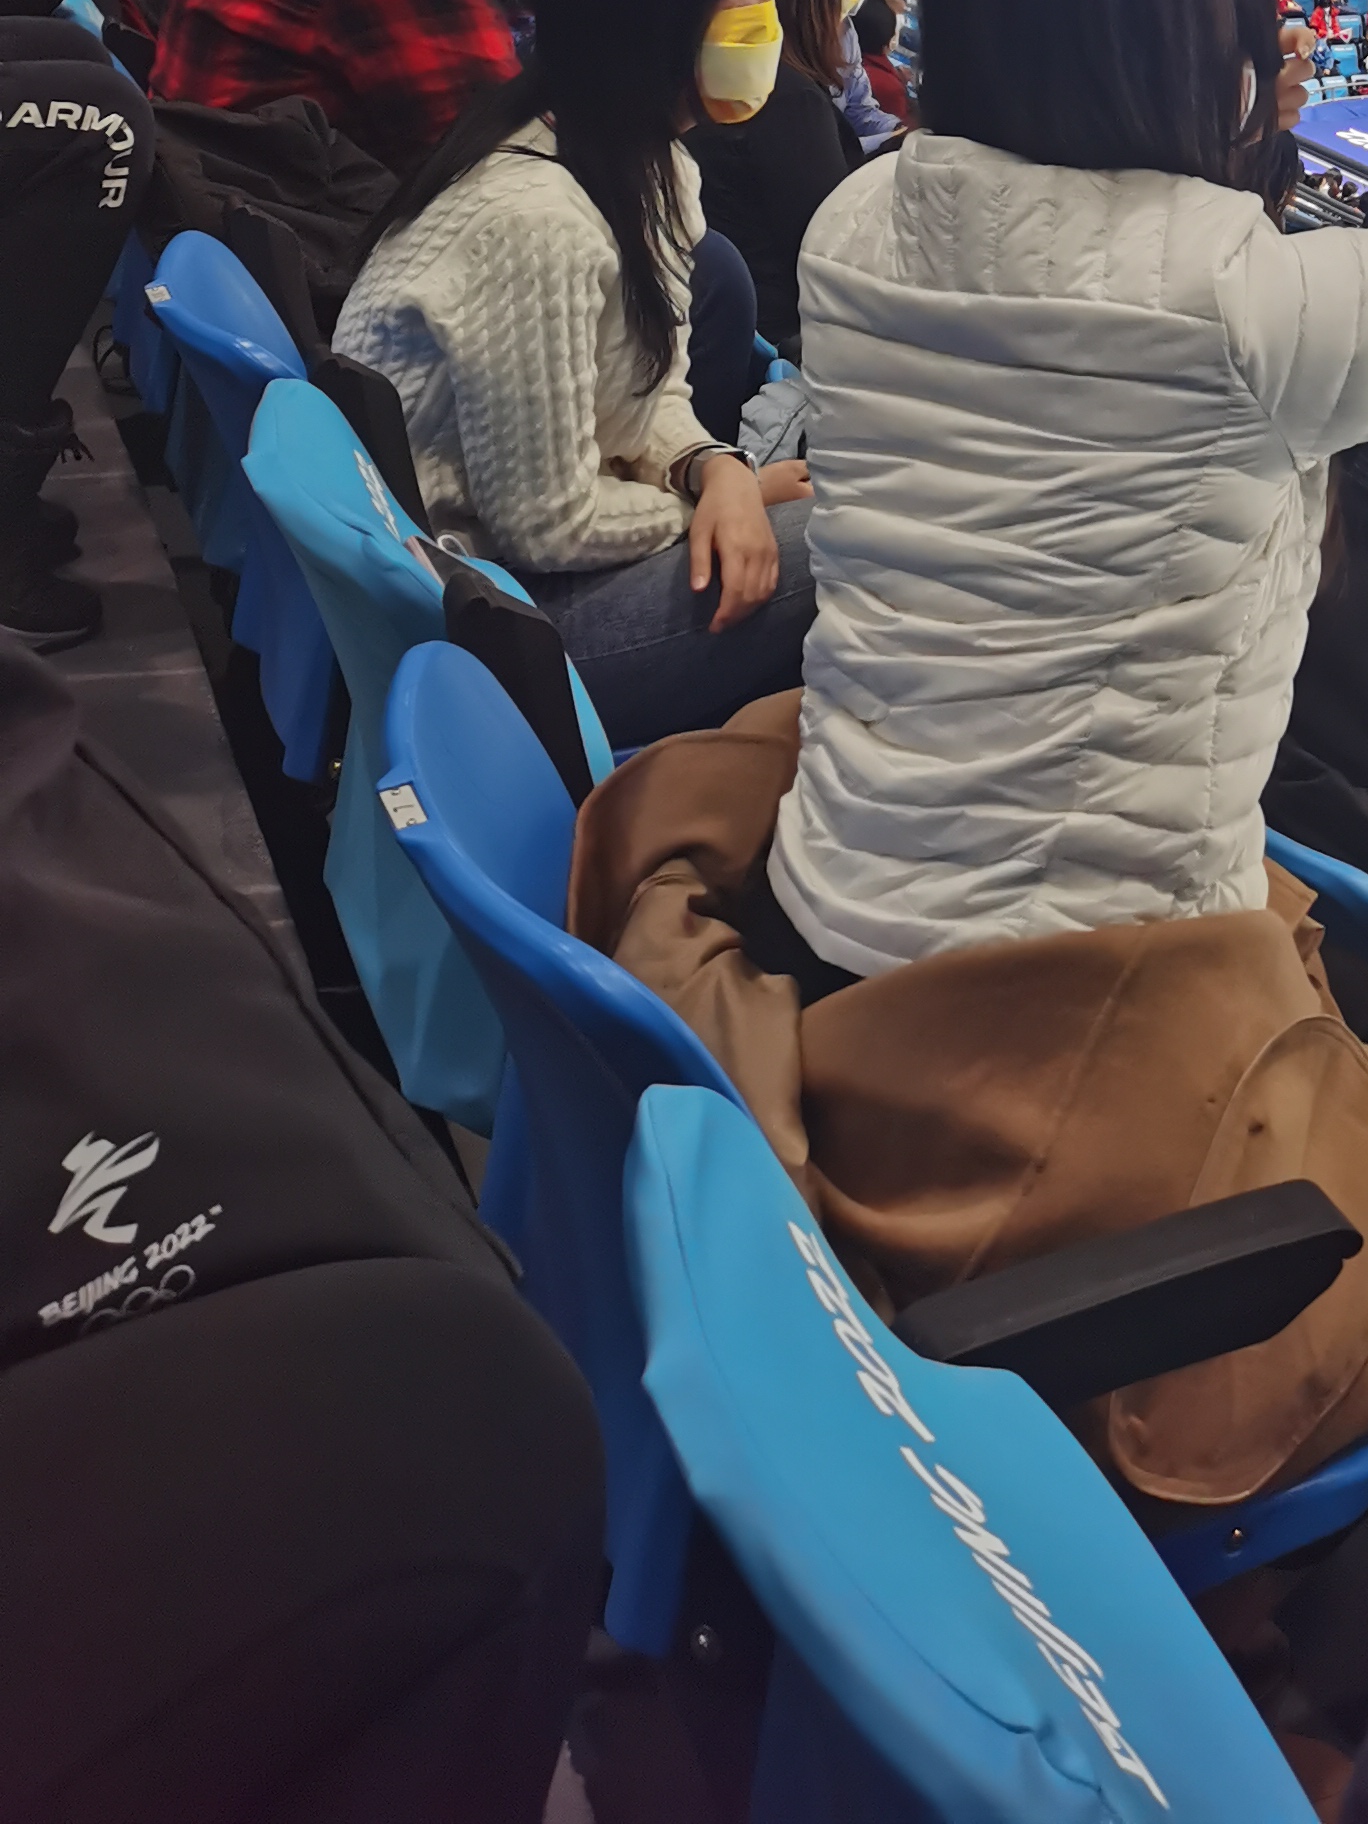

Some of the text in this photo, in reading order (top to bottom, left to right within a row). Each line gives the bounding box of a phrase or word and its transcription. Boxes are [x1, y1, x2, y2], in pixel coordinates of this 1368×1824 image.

[5, 100, 135, 209] ARMOUR
[37, 1212, 216, 1327] BEIJING 2022
[788, 1220, 1170, 1811] BEIJING 2022
